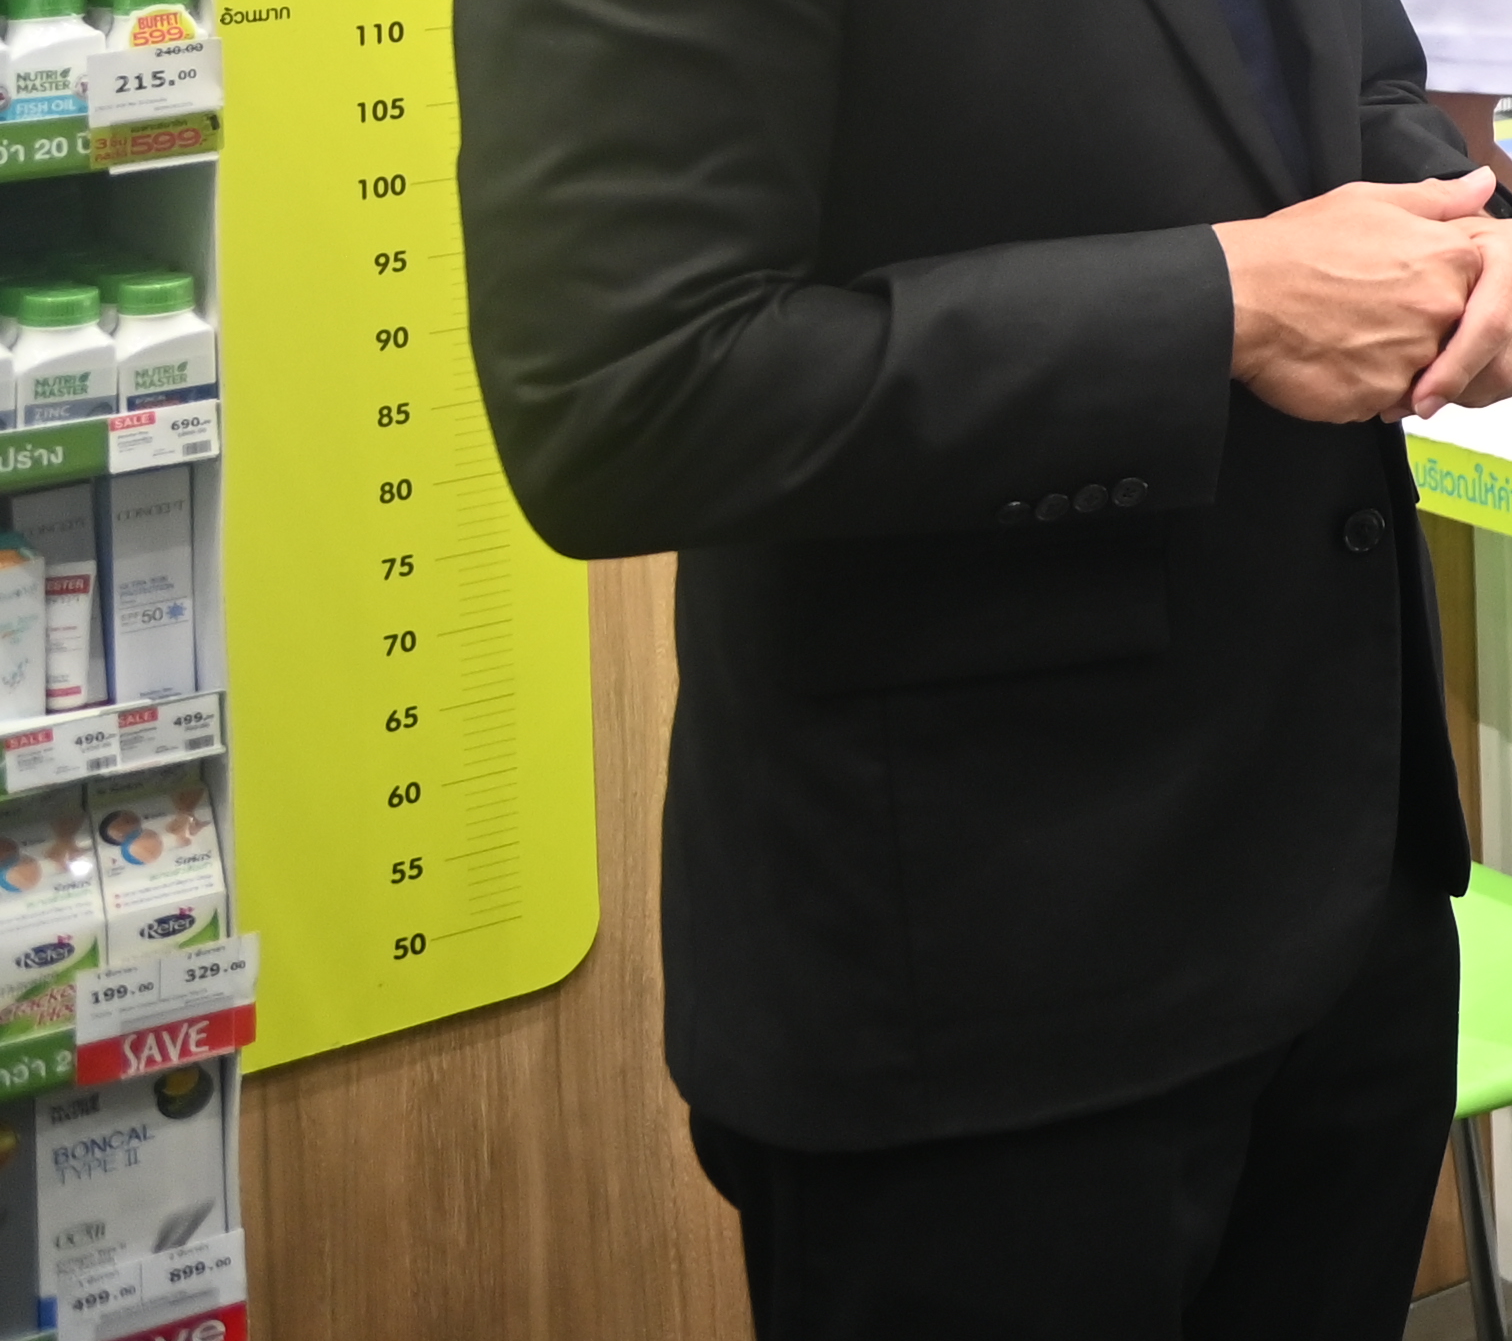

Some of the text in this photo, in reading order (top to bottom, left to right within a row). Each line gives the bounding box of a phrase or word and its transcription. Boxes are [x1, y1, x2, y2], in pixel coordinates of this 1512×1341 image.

[137, 12, 180, 31] BUFFET
[219, 5, 292, 27] อ้วนมาก
[356, 21, 405, 46] 110
[16, 70, 58, 83] NUTRI
[16, 81, 71, 94] MASTER
[114, 68, 198, 94] 215.00
[16, 99, 76, 114] FISH OIL
[358, 174, 407, 200] 100
[375, 326, 410, 351] 90
[113, 412, 151, 430] SALE
[379, 478, 413, 504] 80
[383, 630, 418, 657] 70
[387, 781, 422, 808] 60
[393, 932, 428, 960] 50
[184, 959, 247, 984] 329.00
[91, 981, 155, 1006] 199.00
[122, 1021, 210, 1076] SAVE
[52, 1124, 155, 1167] BONCAL
